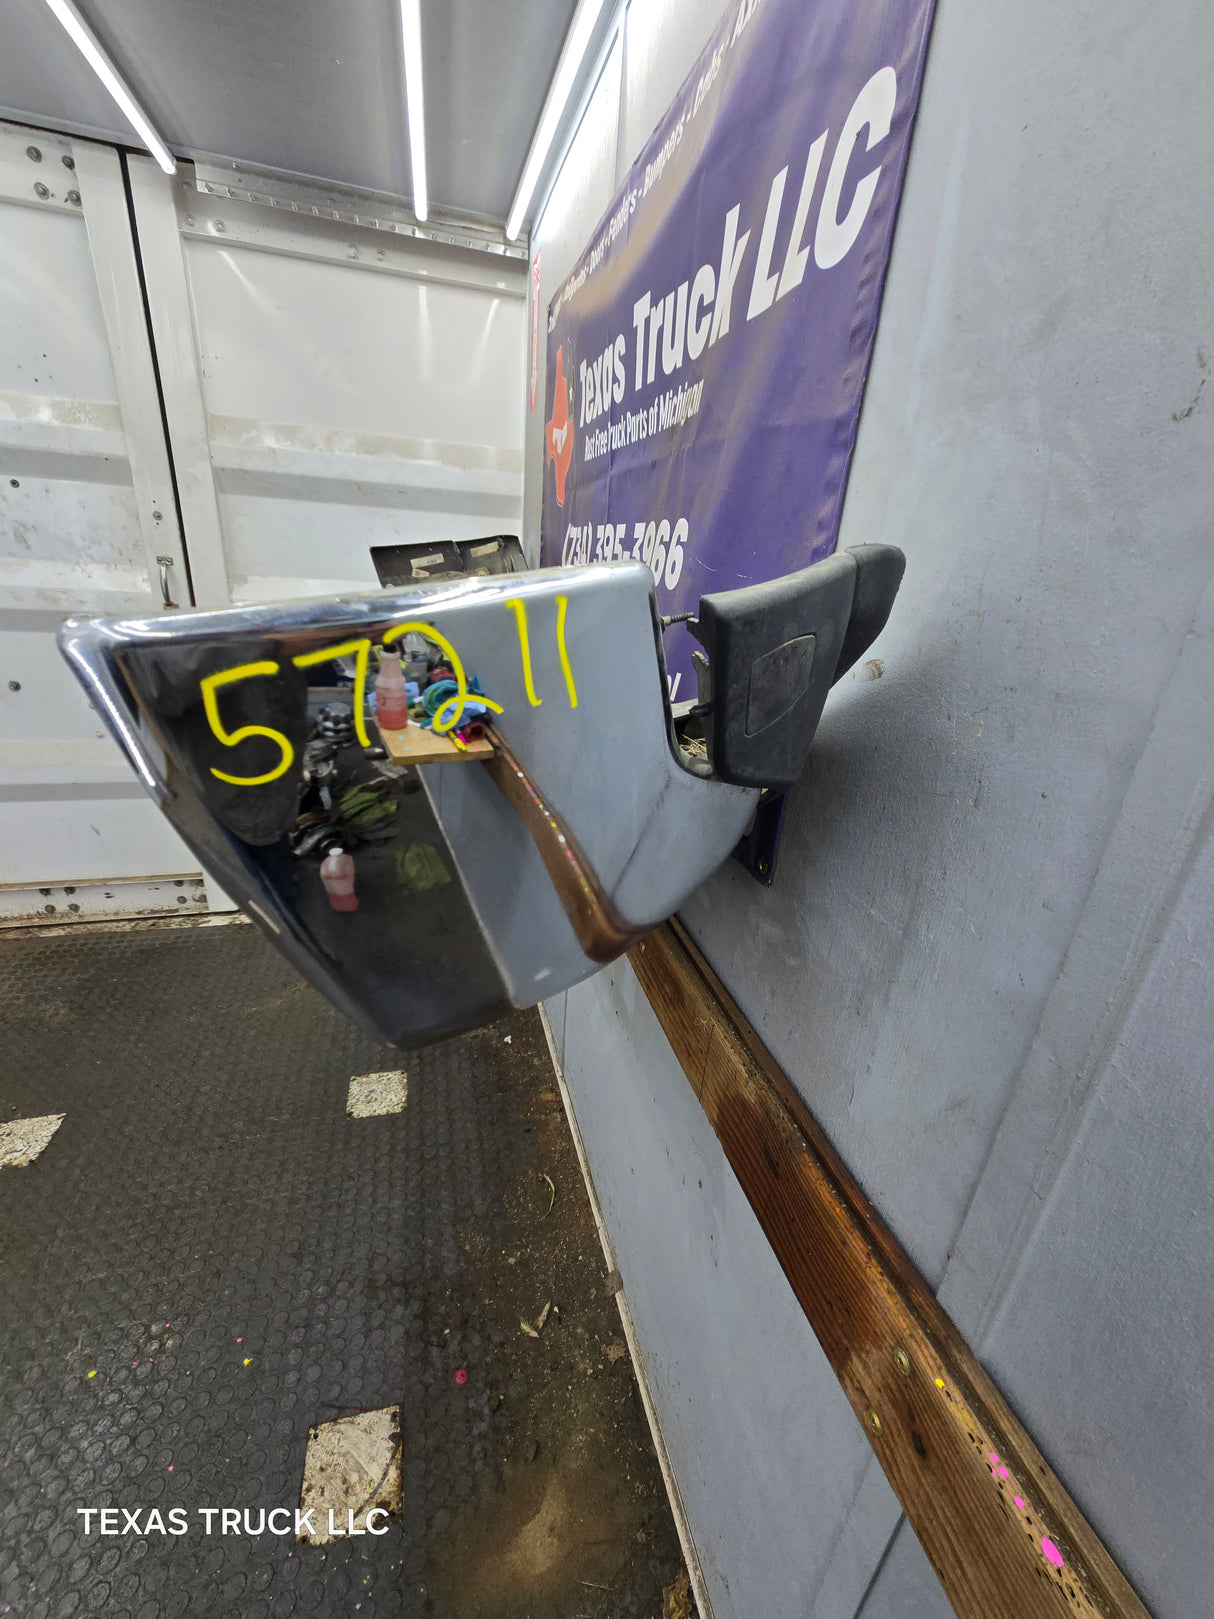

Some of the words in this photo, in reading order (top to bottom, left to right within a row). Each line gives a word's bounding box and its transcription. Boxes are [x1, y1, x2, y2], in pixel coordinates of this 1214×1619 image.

[579, 333, 626, 428] Texas
[633, 203, 751, 392] Truck
[746, 66, 897, 321] LLC
[584, 430, 596, 462] Rust
[595, 427, 608, 457] Free
[608, 414, 626, 452] Truck
[626, 408, 648, 446] Parts
[649, 396, 659, 436] of
[659, 378, 705, 431] Michigan
